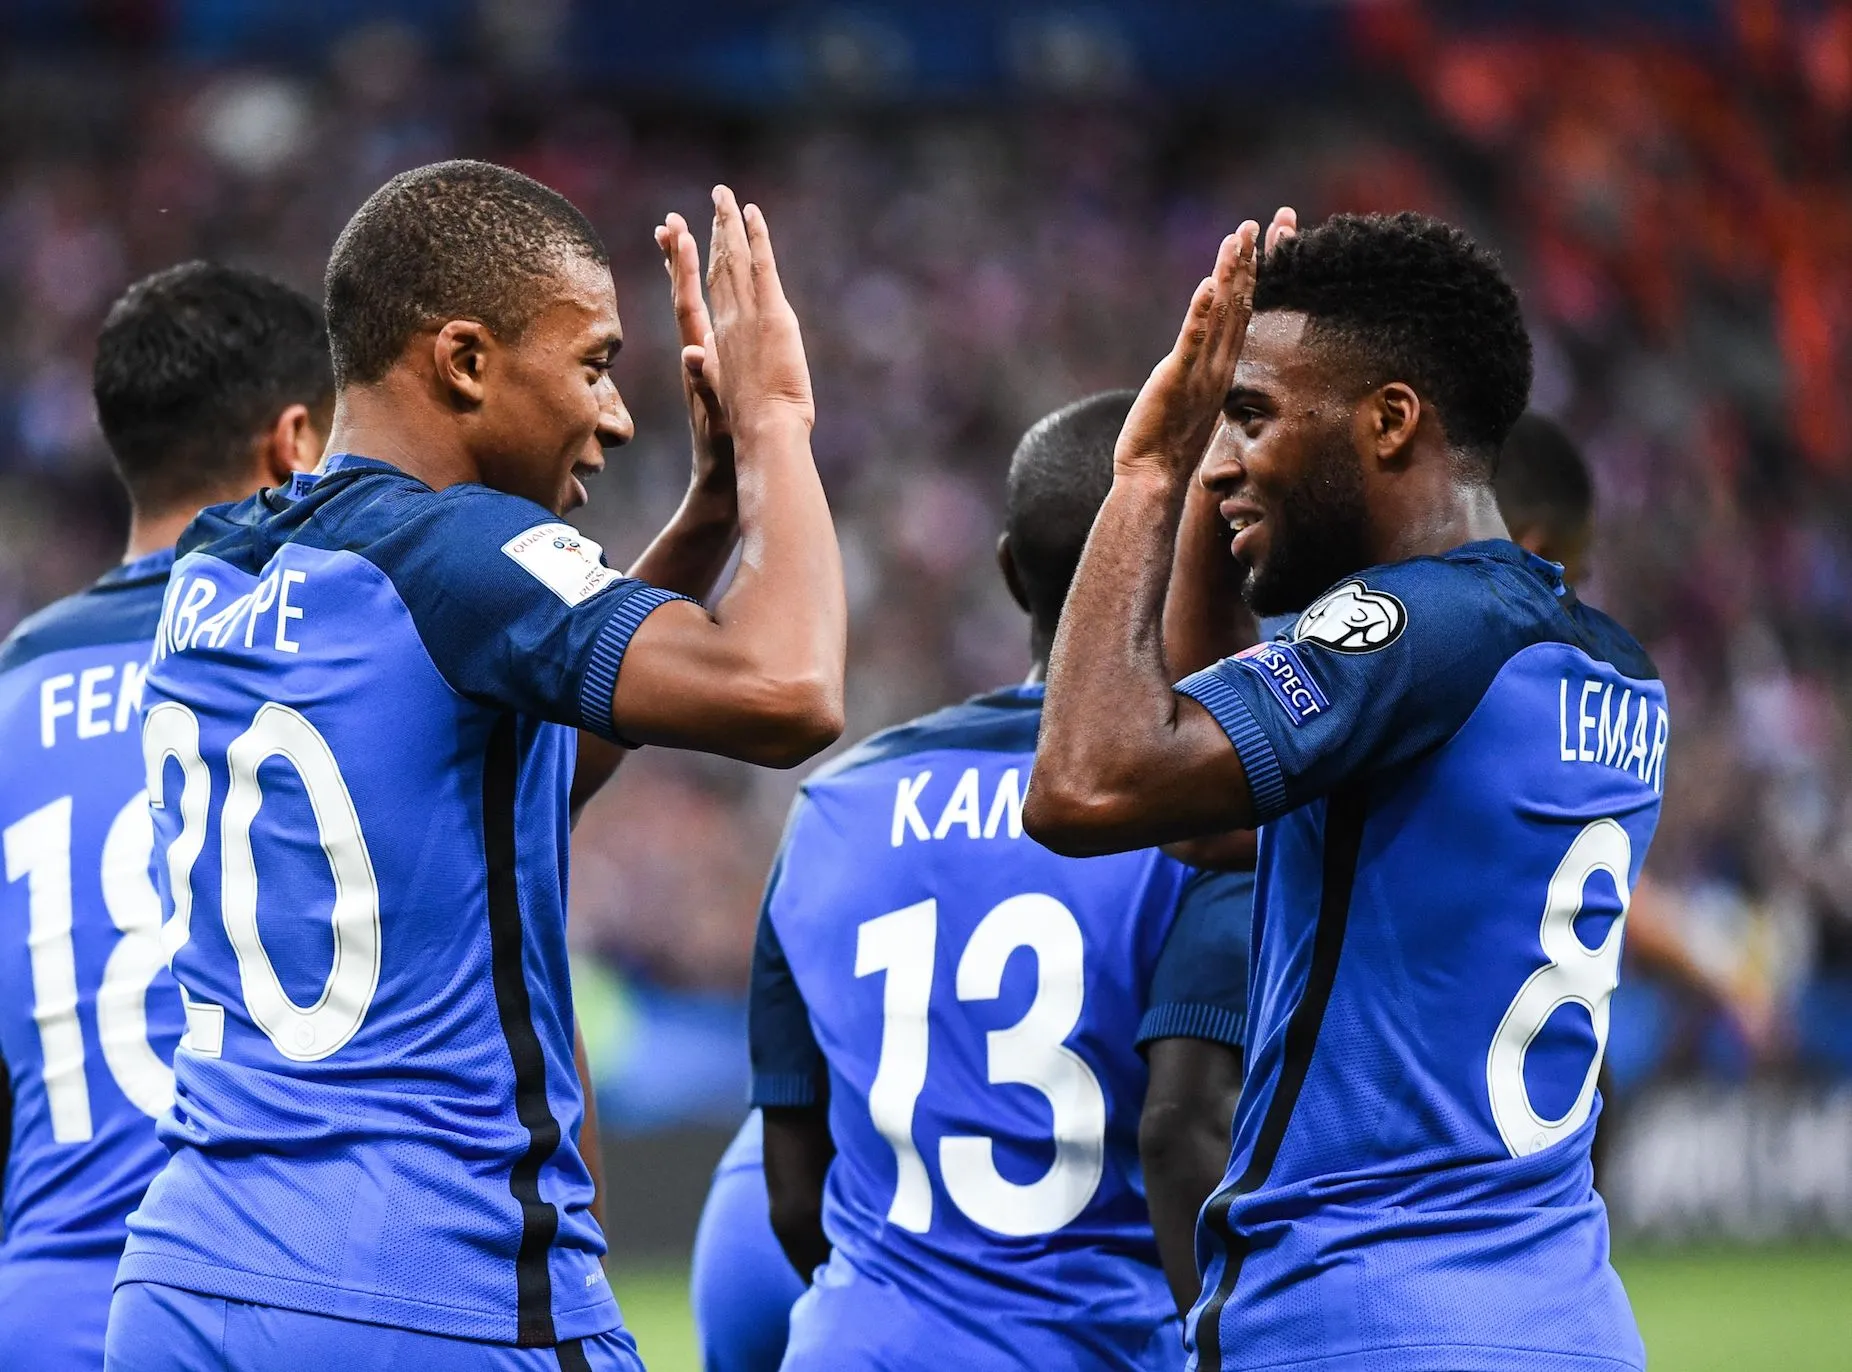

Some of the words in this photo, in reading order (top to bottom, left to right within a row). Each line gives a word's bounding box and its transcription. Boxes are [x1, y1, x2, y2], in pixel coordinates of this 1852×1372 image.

[40, 661, 149, 749] FEK
[1252, 647, 1320, 717] RESPECT
[1560, 678, 1669, 795] LEMAR
[142, 701, 382, 1062] 20
[890, 767, 1028, 848] KAN
[3, 788, 176, 1144] 18
[854, 892, 1106, 1237] 13
[1486, 817, 1632, 1159] 8
